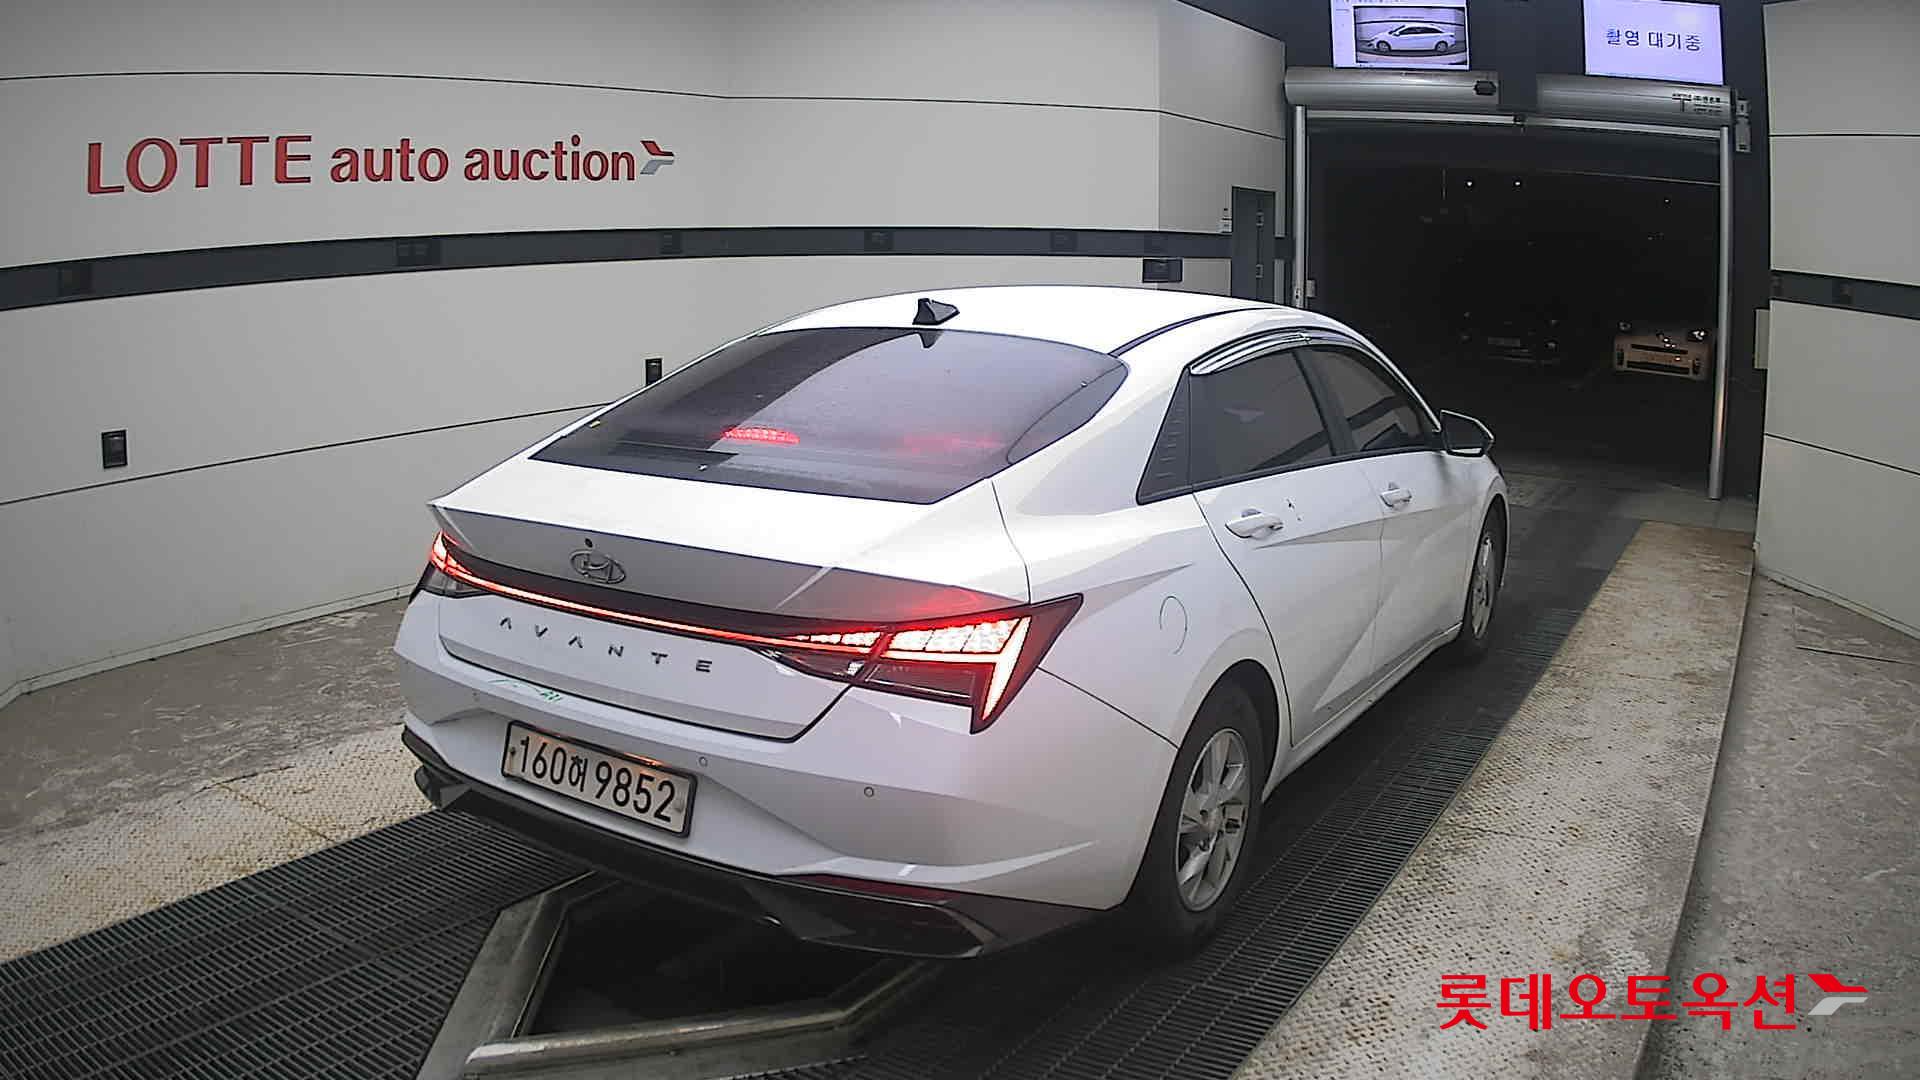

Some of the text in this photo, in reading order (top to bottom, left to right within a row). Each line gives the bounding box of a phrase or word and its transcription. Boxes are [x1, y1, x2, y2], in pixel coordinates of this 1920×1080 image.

[1648, 31, 1701, 51] 대기중
[87, 134, 636, 194] LOTTE auto auction
[499, 616, 713, 673] AVANTE
